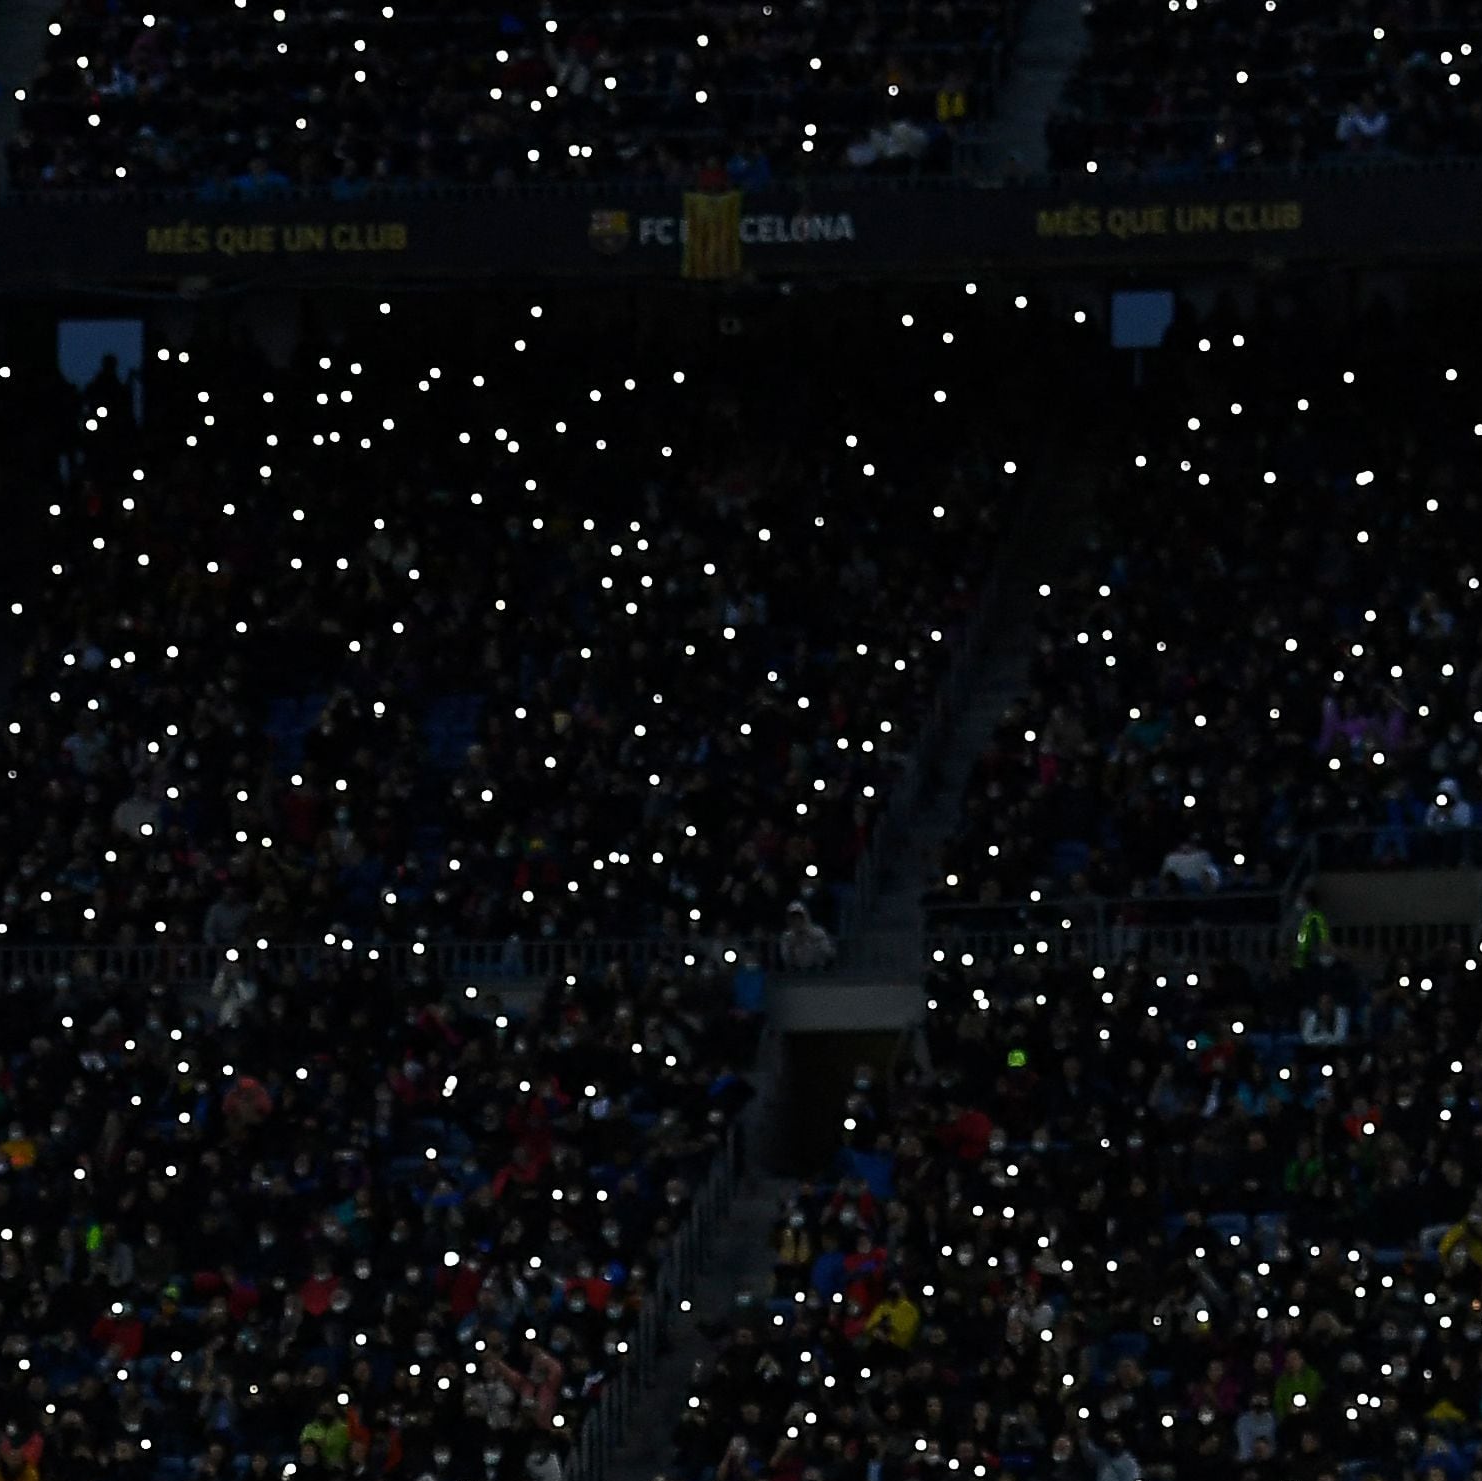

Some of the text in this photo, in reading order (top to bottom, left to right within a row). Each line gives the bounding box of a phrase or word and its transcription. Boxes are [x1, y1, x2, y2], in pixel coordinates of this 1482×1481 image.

[638, 215, 675, 245] FC
[1222, 201, 1303, 234] CLUB
[330, 221, 407, 251] CLUB
